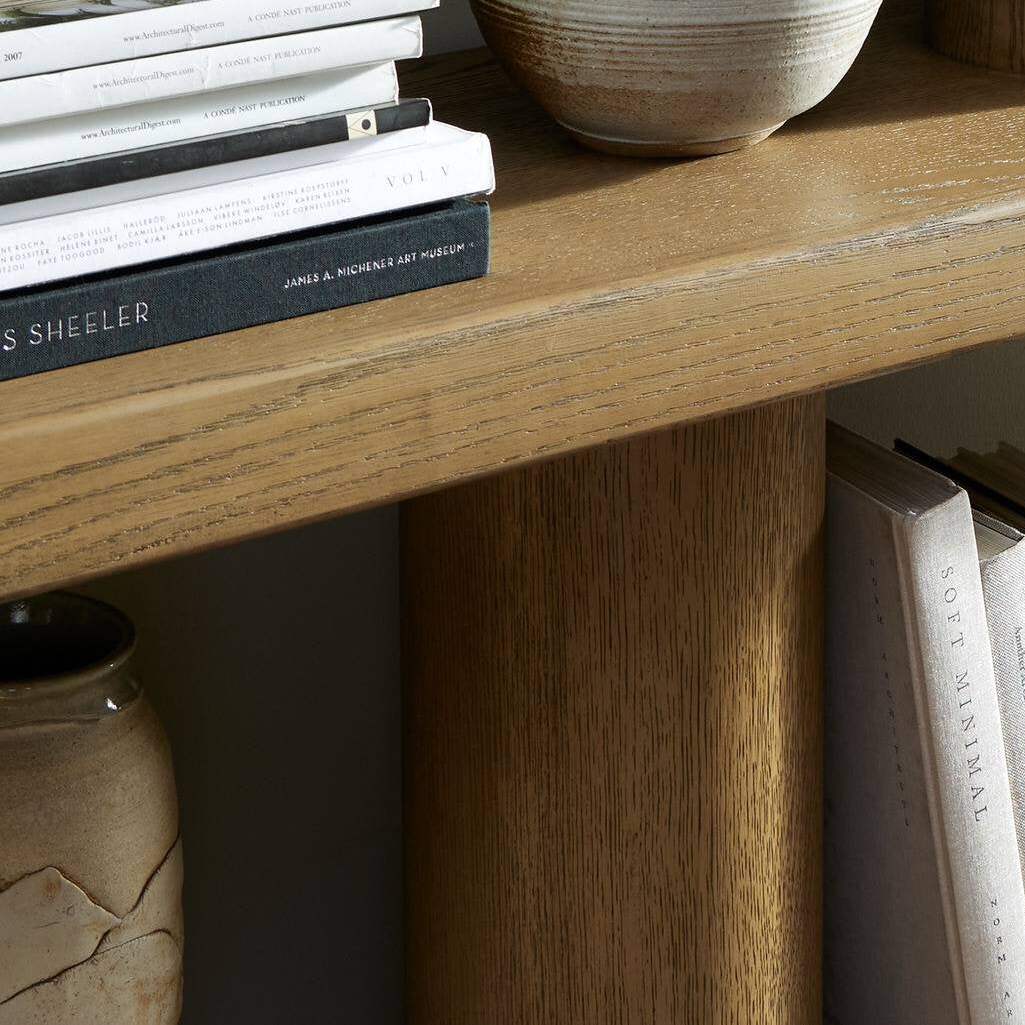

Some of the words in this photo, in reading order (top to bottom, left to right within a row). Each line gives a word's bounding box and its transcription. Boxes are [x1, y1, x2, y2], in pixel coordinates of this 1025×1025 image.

[4, 51, 23, 62] 2007
[123, 21, 225, 43] www.ArchitecturalDigest.com
[247, 15, 253, 23] A
[283, 7, 302, 17] NAST
[304, 0, 353, 14] PUBLICATION
[92, 67, 195, 90] www.ArchitecturalDigest.com
[217, 62, 223, 70] A
[253, 53, 271, 63] NAST
[274, 46, 321, 60] PUBLICATION
[81, 117, 181, 140] www.ArchitecturalDigest.com
[239, 103, 257, 113] NAST
[259, 95, 306, 109] PUBLICATION
[387, 170, 426, 187] VOL
[284, 273, 319, 289] JAMES
[323, 270, 334, 281] A.
[338, 257, 395, 278] MICHENER
[397, 252, 417, 266] ART
[421, 242, 465, 260] MUSEUM
[30, 302, 149, 345] SHEELER
[941, 566, 965, 648] SOFT
[955, 668, 988, 822] MINIMAL
[991, 898, 1007, 964] NORM
